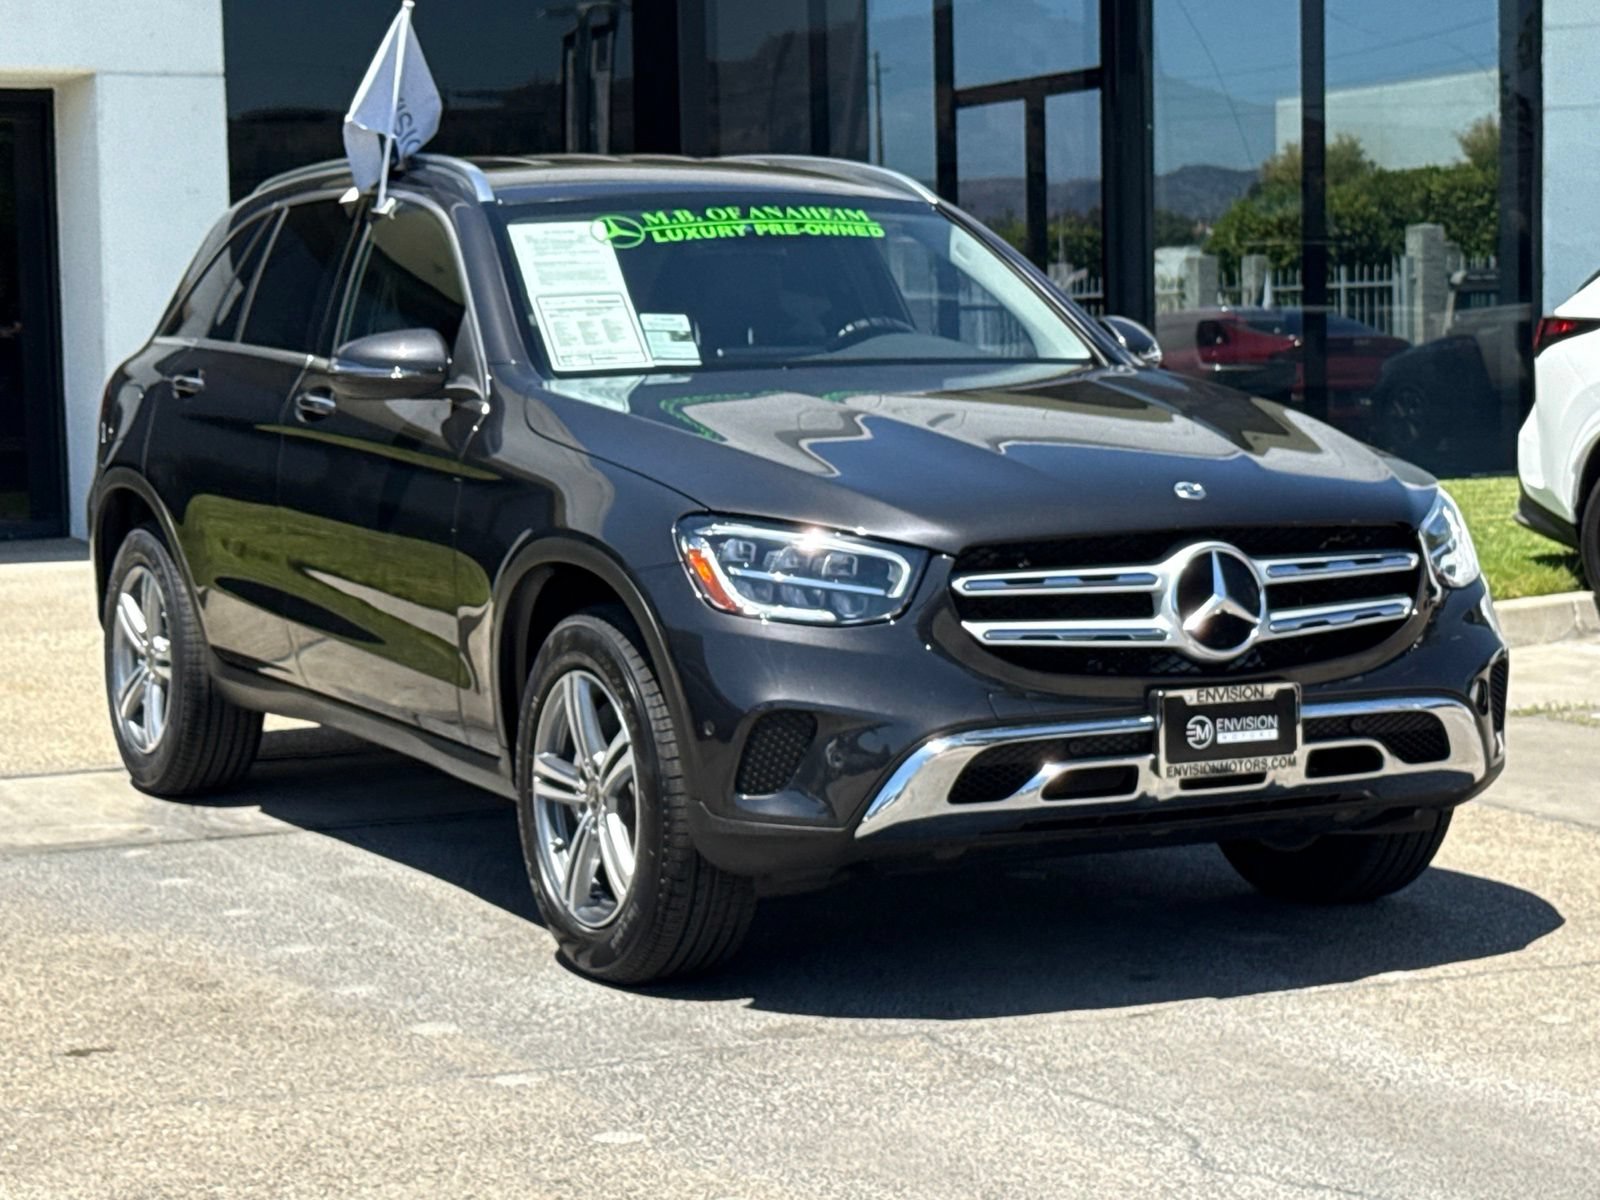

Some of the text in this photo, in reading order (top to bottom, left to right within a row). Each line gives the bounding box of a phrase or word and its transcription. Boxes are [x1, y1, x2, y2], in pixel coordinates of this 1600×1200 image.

[641, 206, 870, 226] M.B. OF ANAHEIM
[651, 222, 885, 243] LUXURY PRE-OWNED
[1196, 684, 1265, 703] ENVISION
[1216, 714, 1279, 731] ENVISION
[1166, 756, 1297, 778] ENVISIONMOTORS.COM
